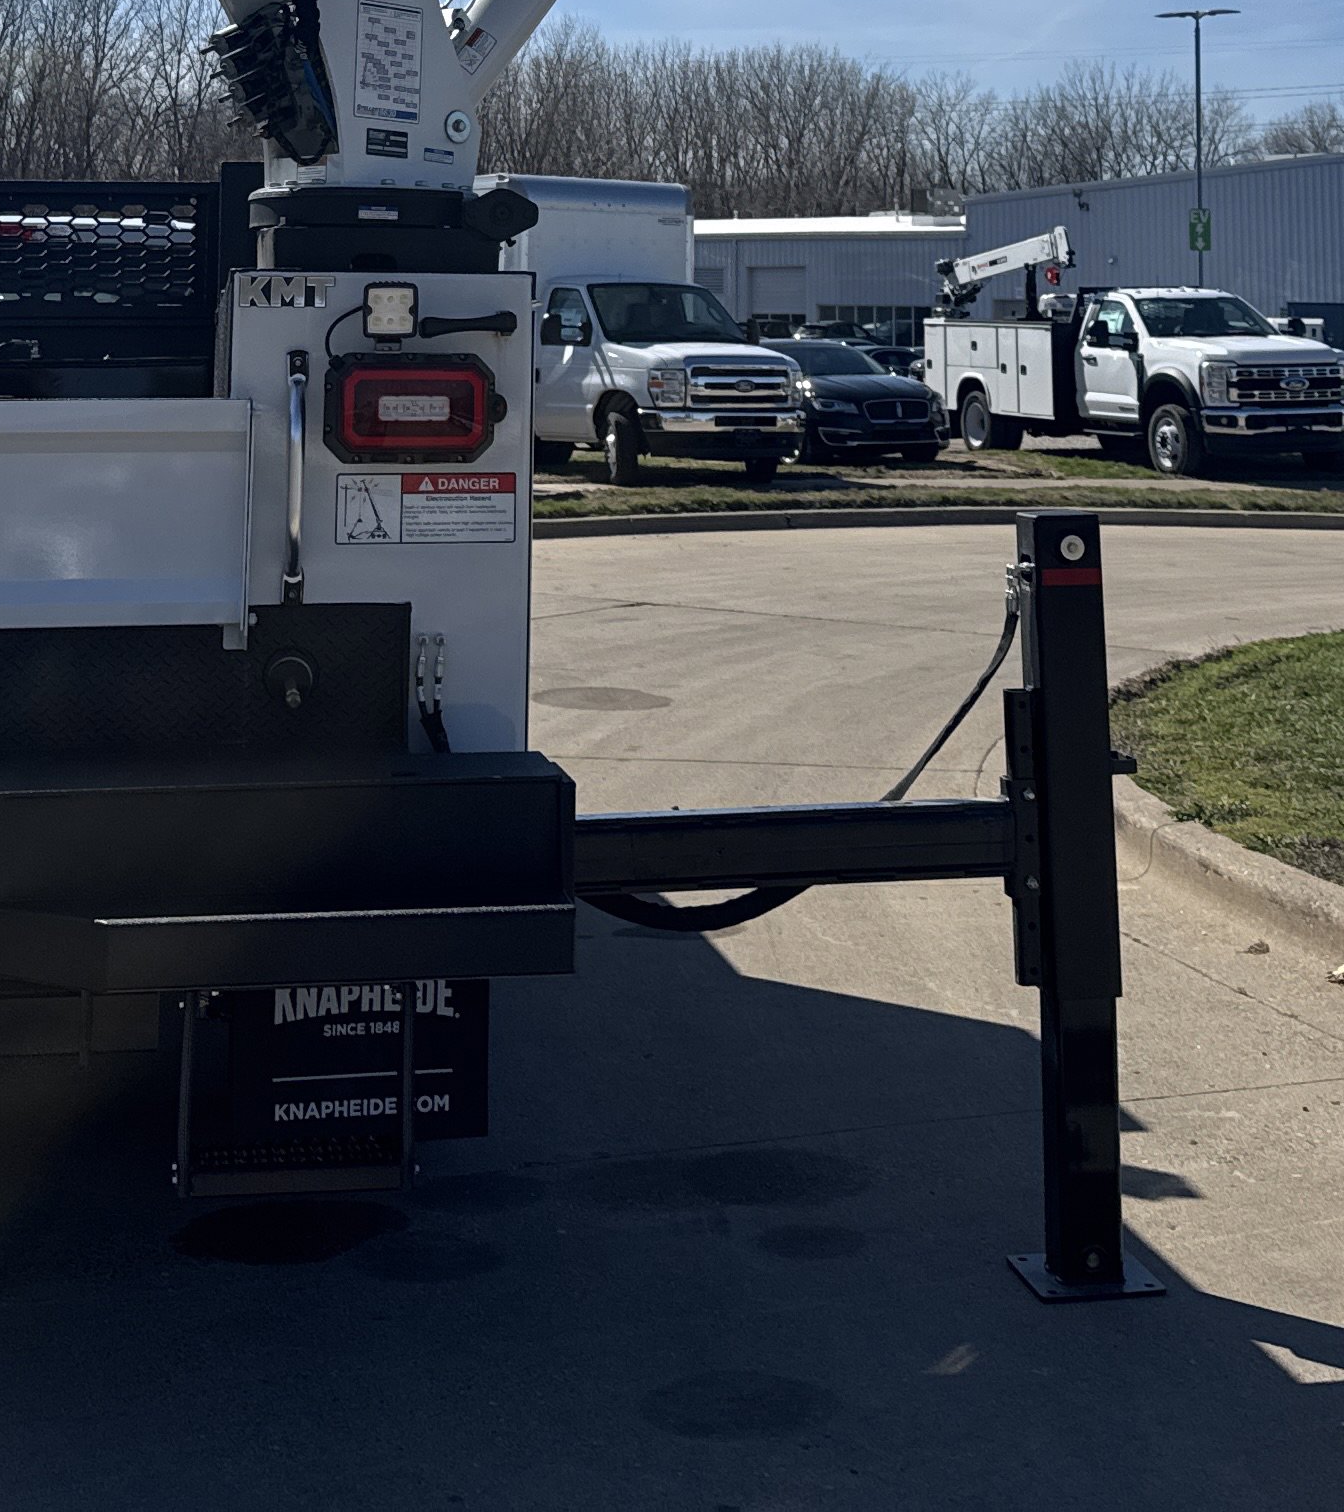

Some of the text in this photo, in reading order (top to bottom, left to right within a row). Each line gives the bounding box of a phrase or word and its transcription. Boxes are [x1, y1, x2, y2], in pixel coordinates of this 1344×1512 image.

[1190, 209, 1209, 223] EV
[239, 276, 335, 307] KMT
[438, 478, 499, 490] DANGER
[274, 979, 455, 1025] KNAPHEDE
[323, 1021, 400, 1037] SINCE 1848
[274, 1094, 450, 1122] KNAPHEIDEOM
